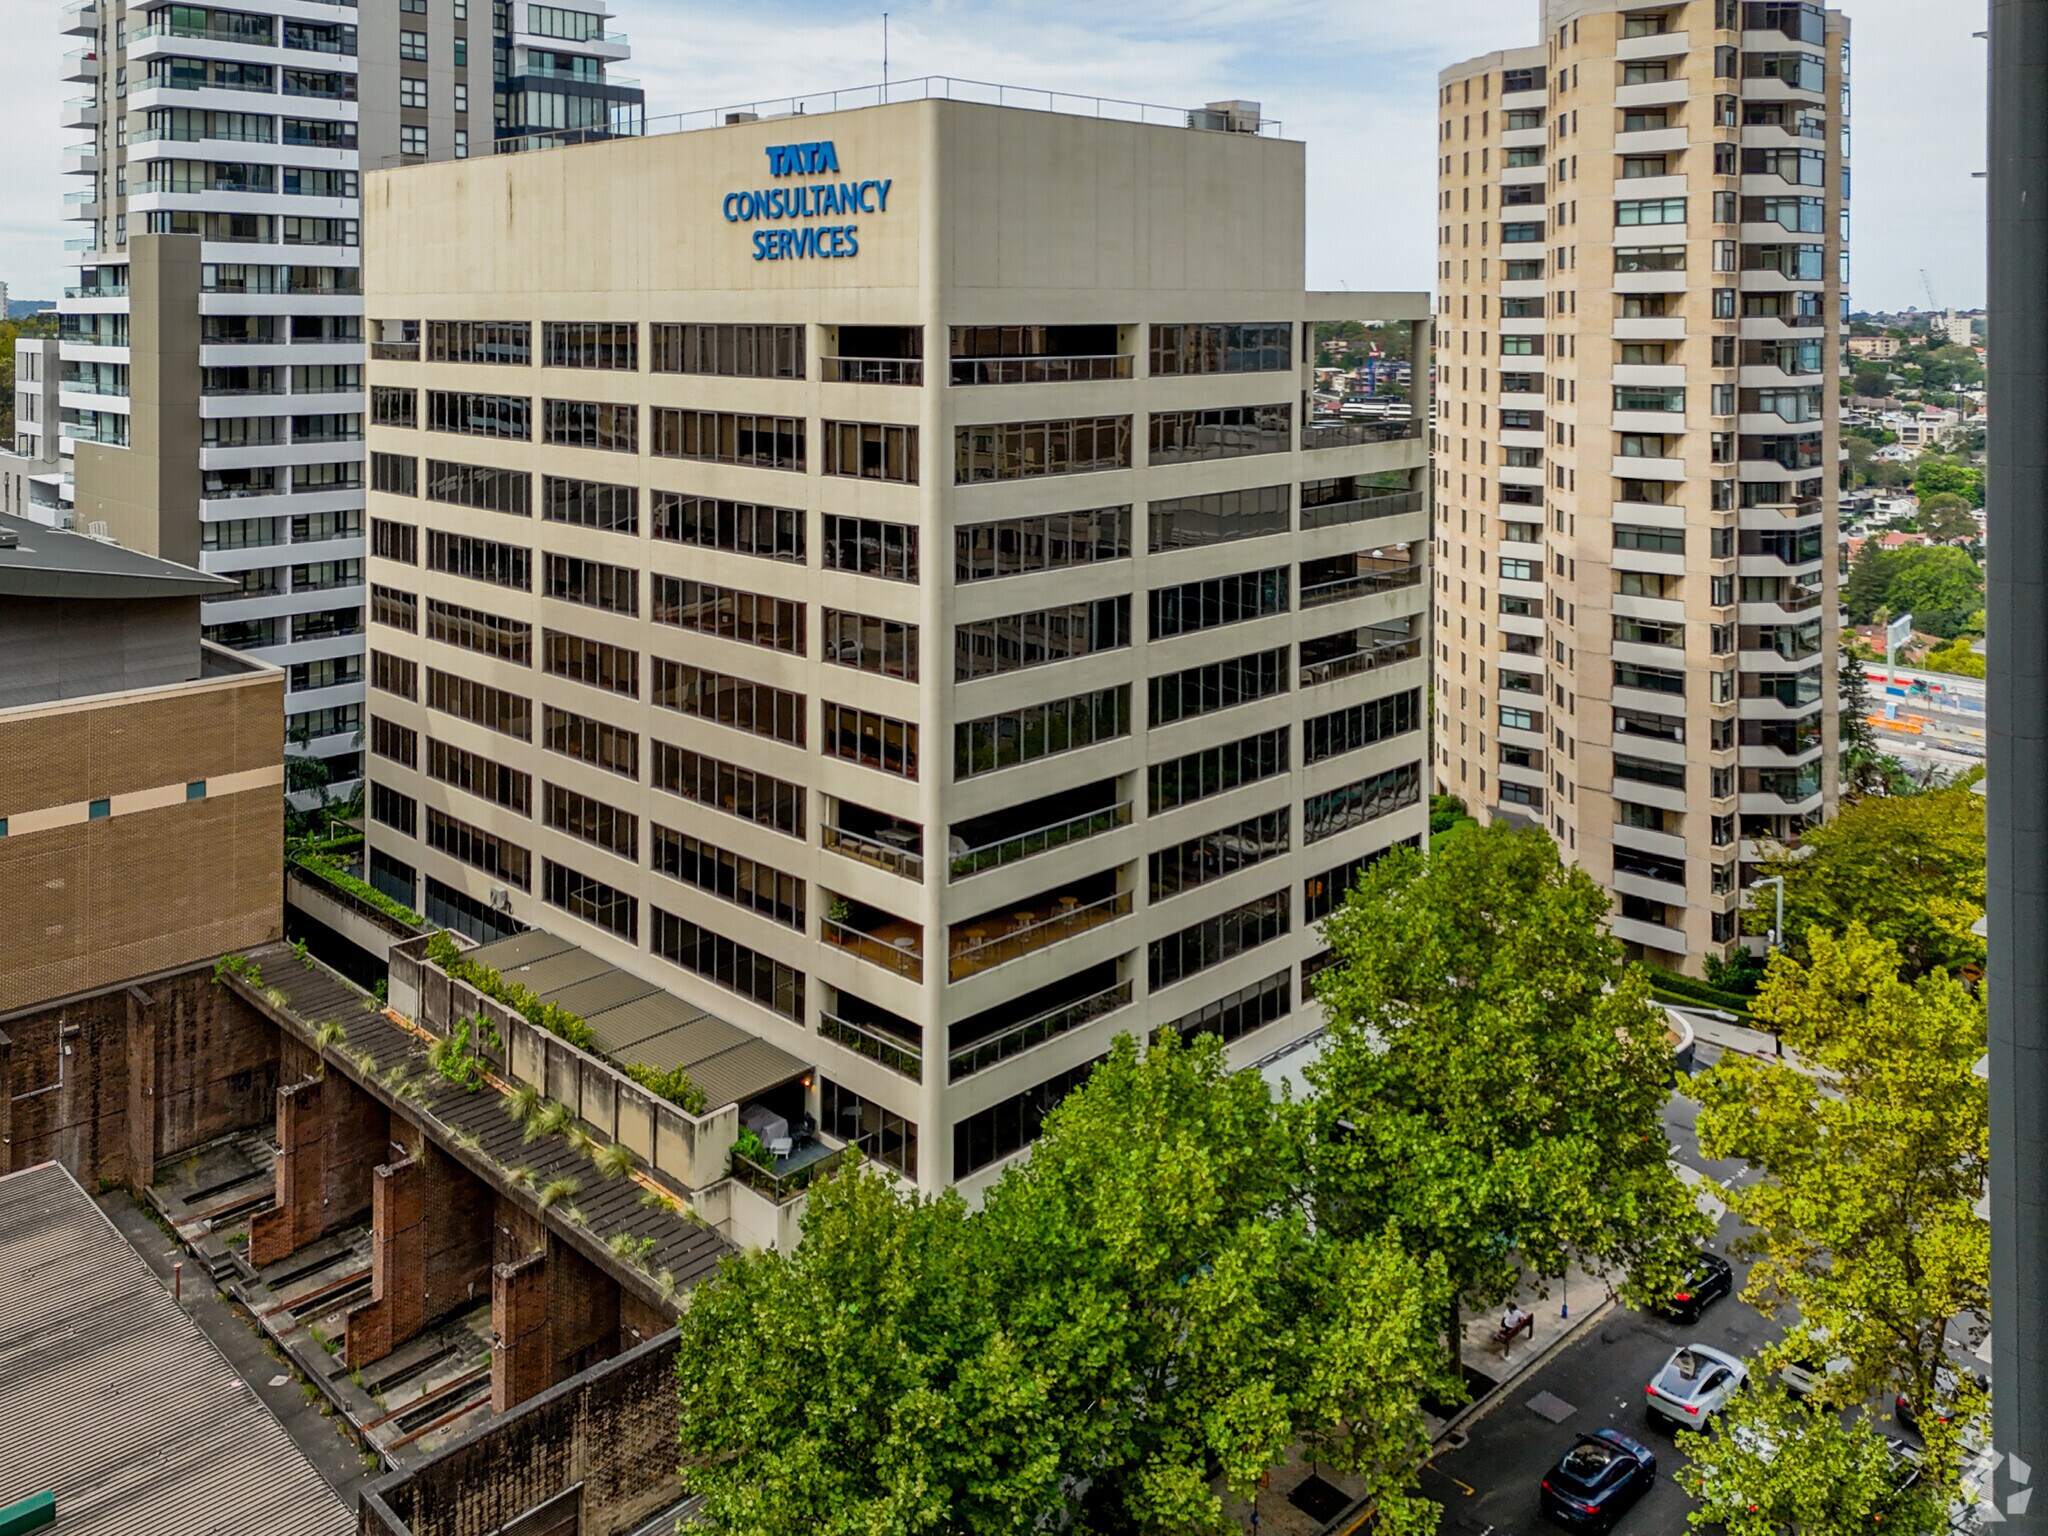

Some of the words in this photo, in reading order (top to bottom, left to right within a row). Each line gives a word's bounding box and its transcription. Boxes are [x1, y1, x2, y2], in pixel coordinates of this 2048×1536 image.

[765, 141, 839, 176] TATA
[723, 179, 891, 222] CONSULTANCY
[752, 225, 859, 260] SERVICES
